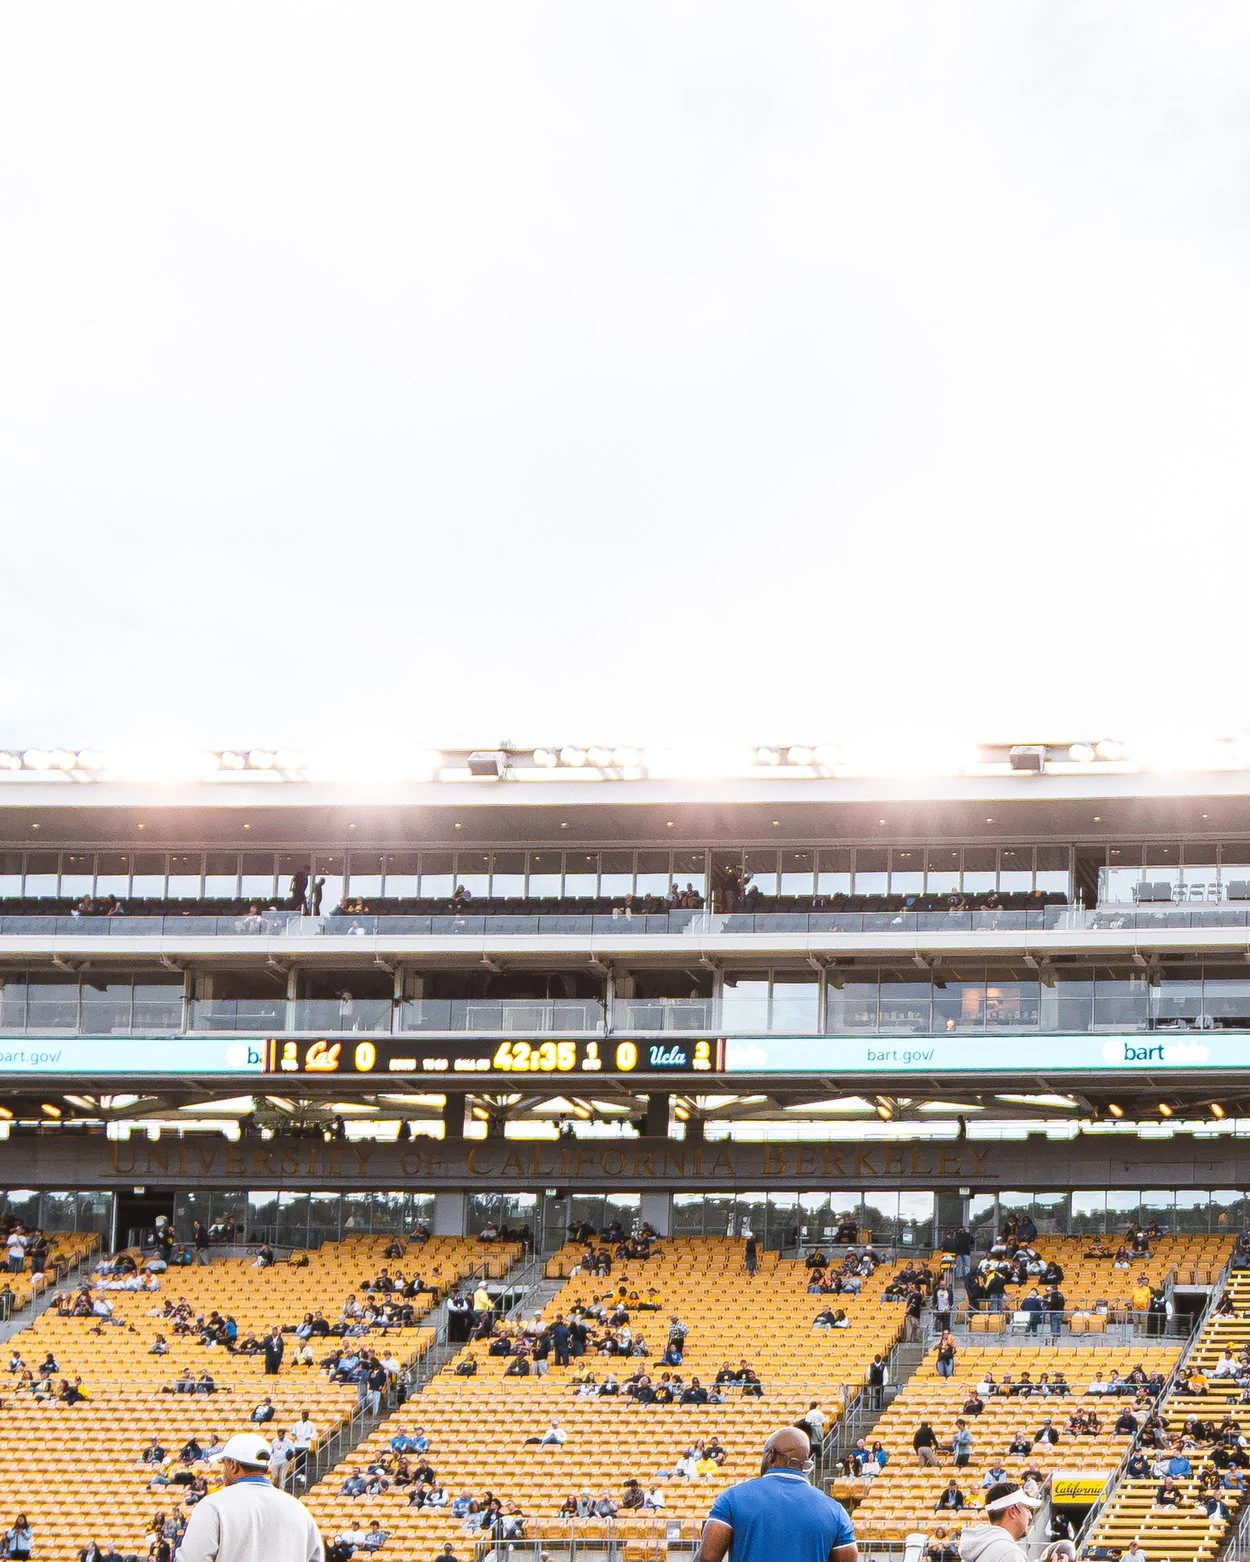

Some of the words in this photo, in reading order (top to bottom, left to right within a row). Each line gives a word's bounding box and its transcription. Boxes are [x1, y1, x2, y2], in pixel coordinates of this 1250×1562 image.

[305, 1040, 341, 1071] Cal
[355, 1042, 376, 1071] 0
[494, 1041, 576, 1071] 42:35
[616, 1042, 637, 1071] 0
[866, 1048, 935, 1064] bart.gov/
[109, 1145, 376, 1176] UNIVERSITY
[465, 1144, 737, 1176] CALIFORNIA
[761, 1145, 996, 1176] BERKELEY
